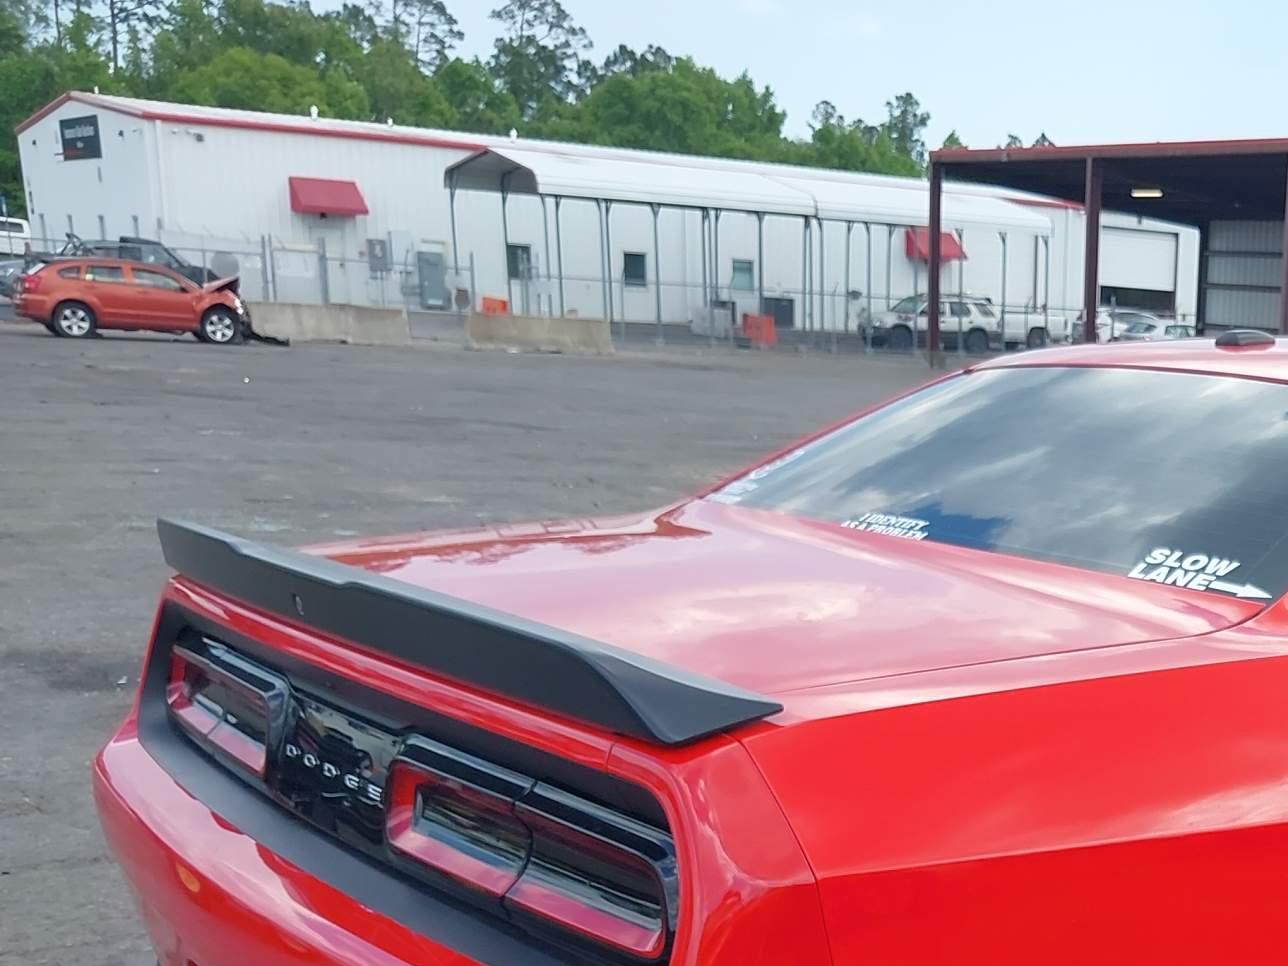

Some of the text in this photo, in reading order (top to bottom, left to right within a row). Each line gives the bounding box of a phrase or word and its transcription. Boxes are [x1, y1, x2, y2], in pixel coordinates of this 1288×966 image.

[865, 512, 930, 531] IDENTIFY
[865, 524, 929, 541] PROBLEM
[1128, 561, 1217, 591] LANE
[1144, 547, 1240, 577] SLOW
[285, 743, 383, 801] DODGE
